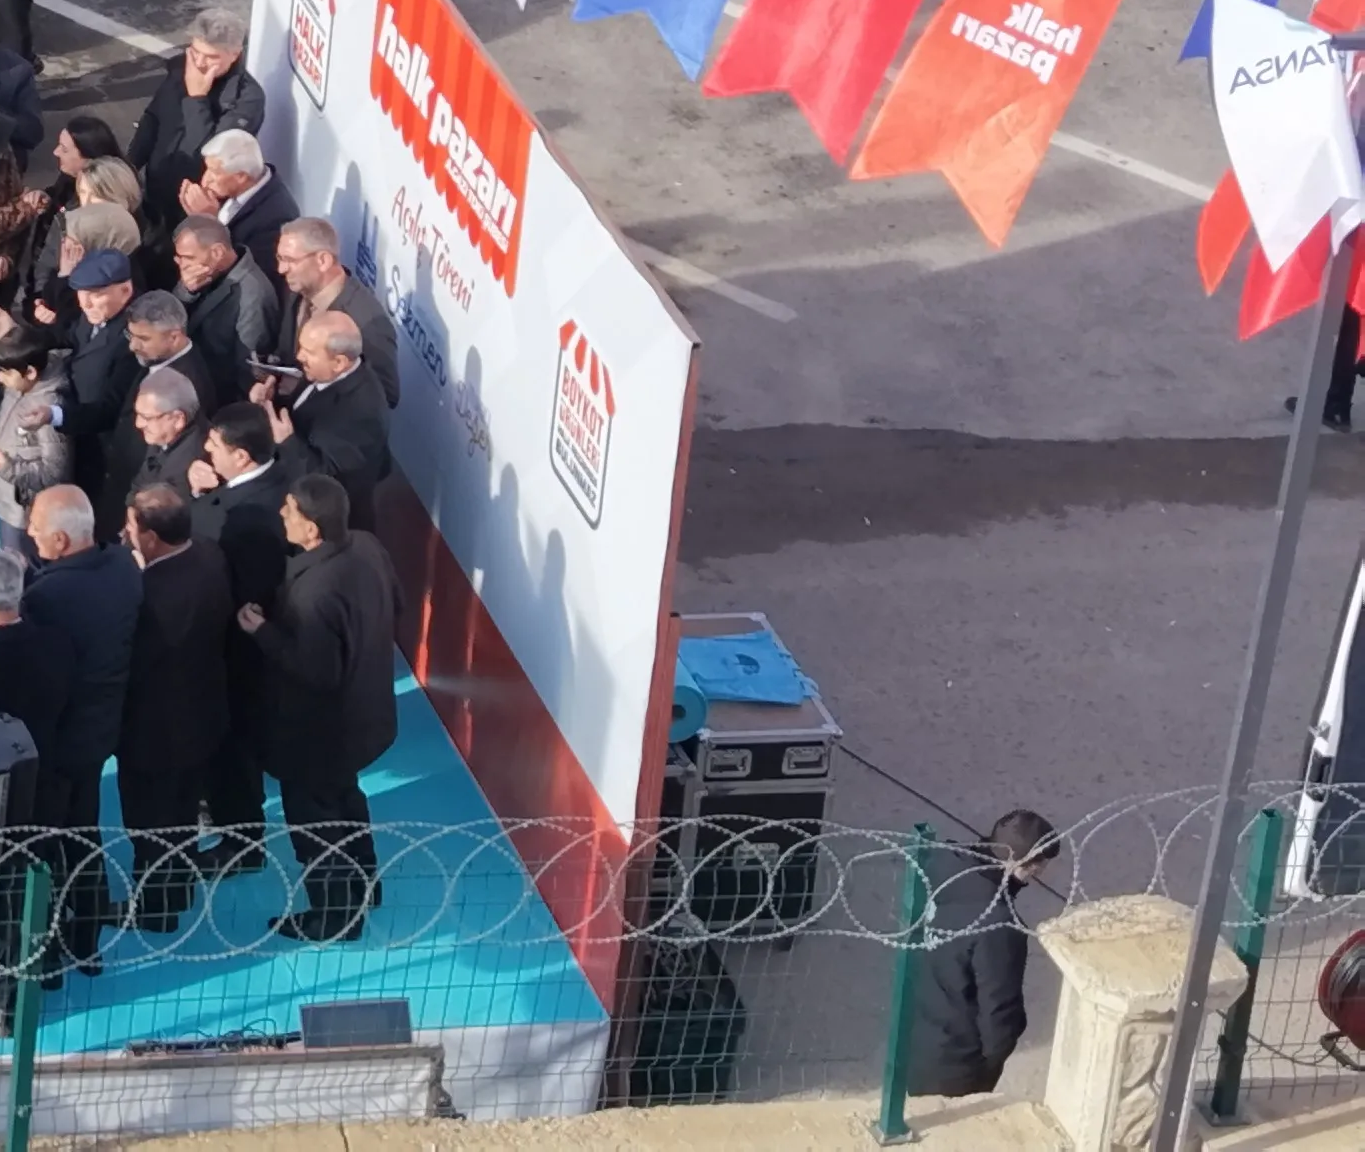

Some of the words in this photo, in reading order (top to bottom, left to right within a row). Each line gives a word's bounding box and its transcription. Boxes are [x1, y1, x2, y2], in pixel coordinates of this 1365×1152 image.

[296, 3, 324, 67] HALK
[377, 3, 435, 119] halk
[429, 93, 518, 239] pazarı
[432, 224, 475, 313] Töreni
[562, 365, 604, 445] BOYKOT
